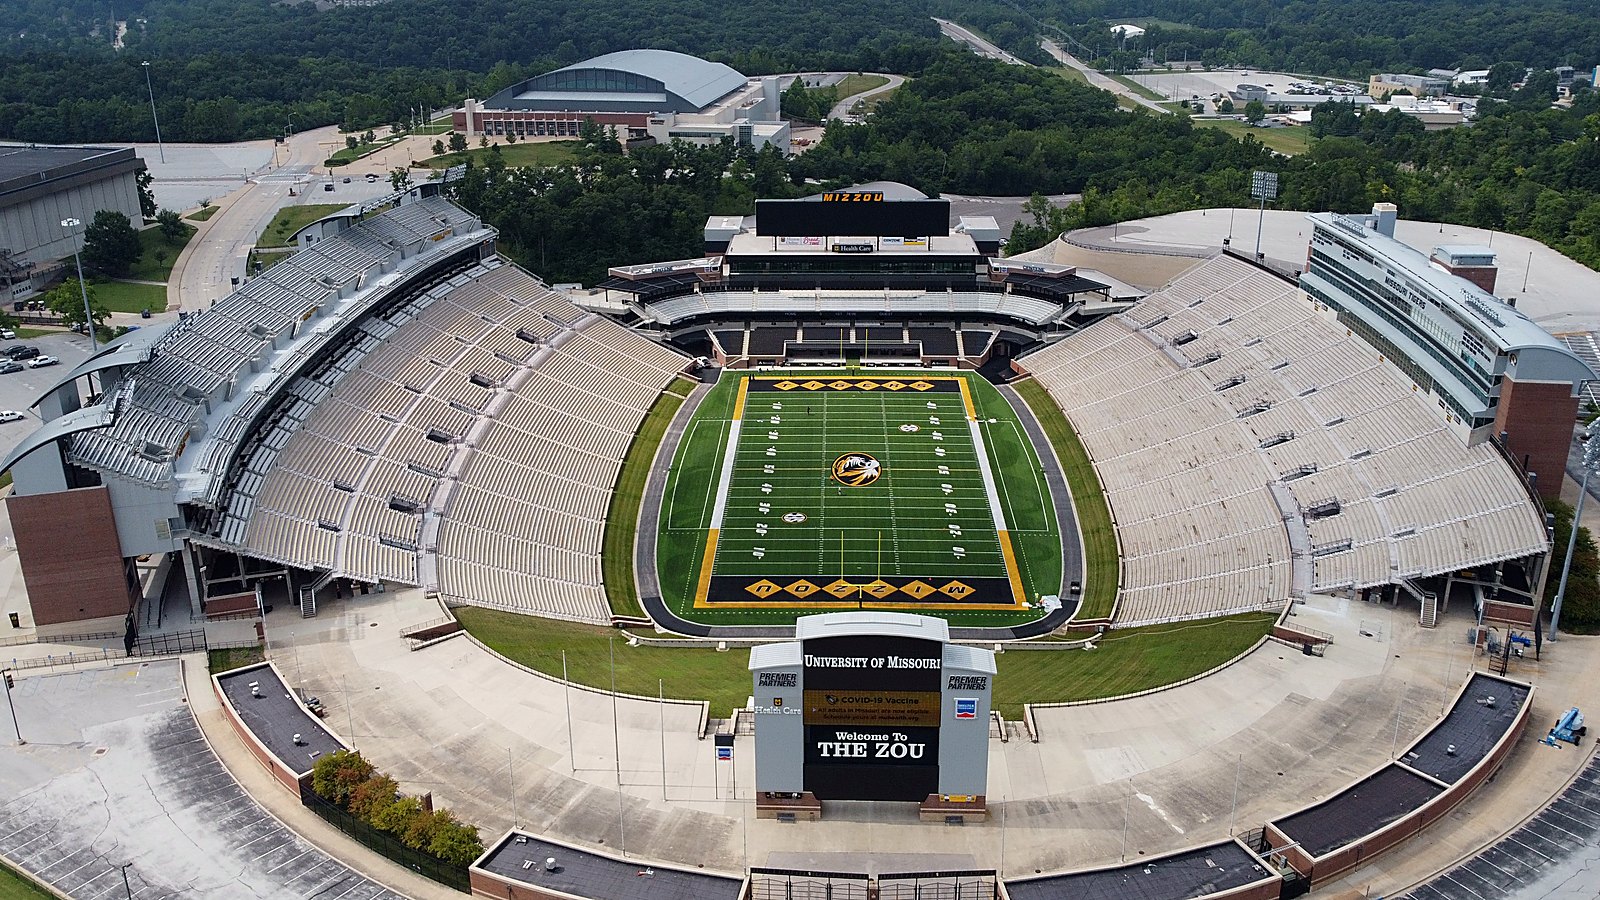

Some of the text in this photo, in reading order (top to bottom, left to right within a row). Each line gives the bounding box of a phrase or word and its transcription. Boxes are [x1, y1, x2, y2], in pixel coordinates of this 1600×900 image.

[823, 193, 883, 202] MIZZOU
[1385, 276, 1426, 310] MISSOURI TIGERS
[759, 672, 797, 681] PREMIER
[948, 675, 987, 684] PREMIER
[841, 696, 919, 705] COVID-19 Vaccine
[754, 706, 801, 715] Health Care
[835, 731, 908, 741] Welcome To
[817, 742, 926, 758] THE ZOU
